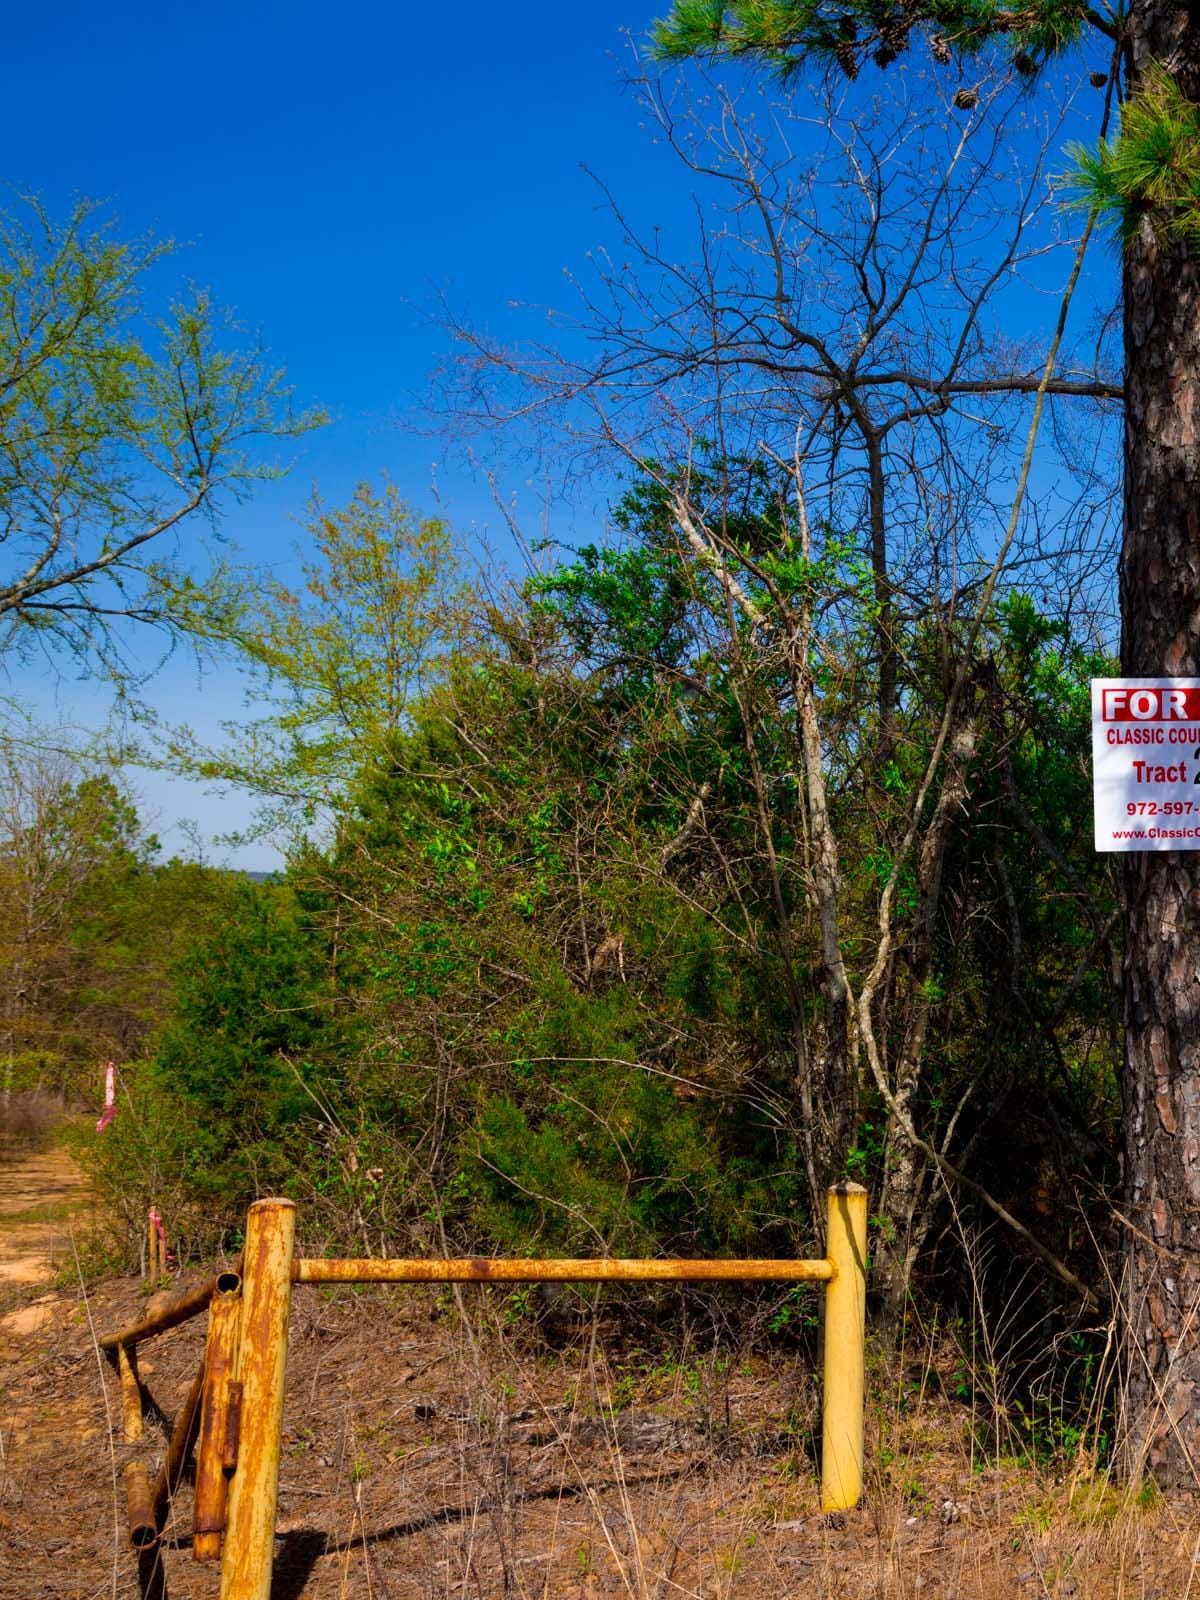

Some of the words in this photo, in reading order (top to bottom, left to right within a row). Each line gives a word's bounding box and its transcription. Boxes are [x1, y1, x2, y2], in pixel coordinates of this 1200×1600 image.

[1105, 690, 1189, 720] FOR
[1107, 729, 1165, 745] CLASSIC
[1133, 761, 1187, 784] Tract
